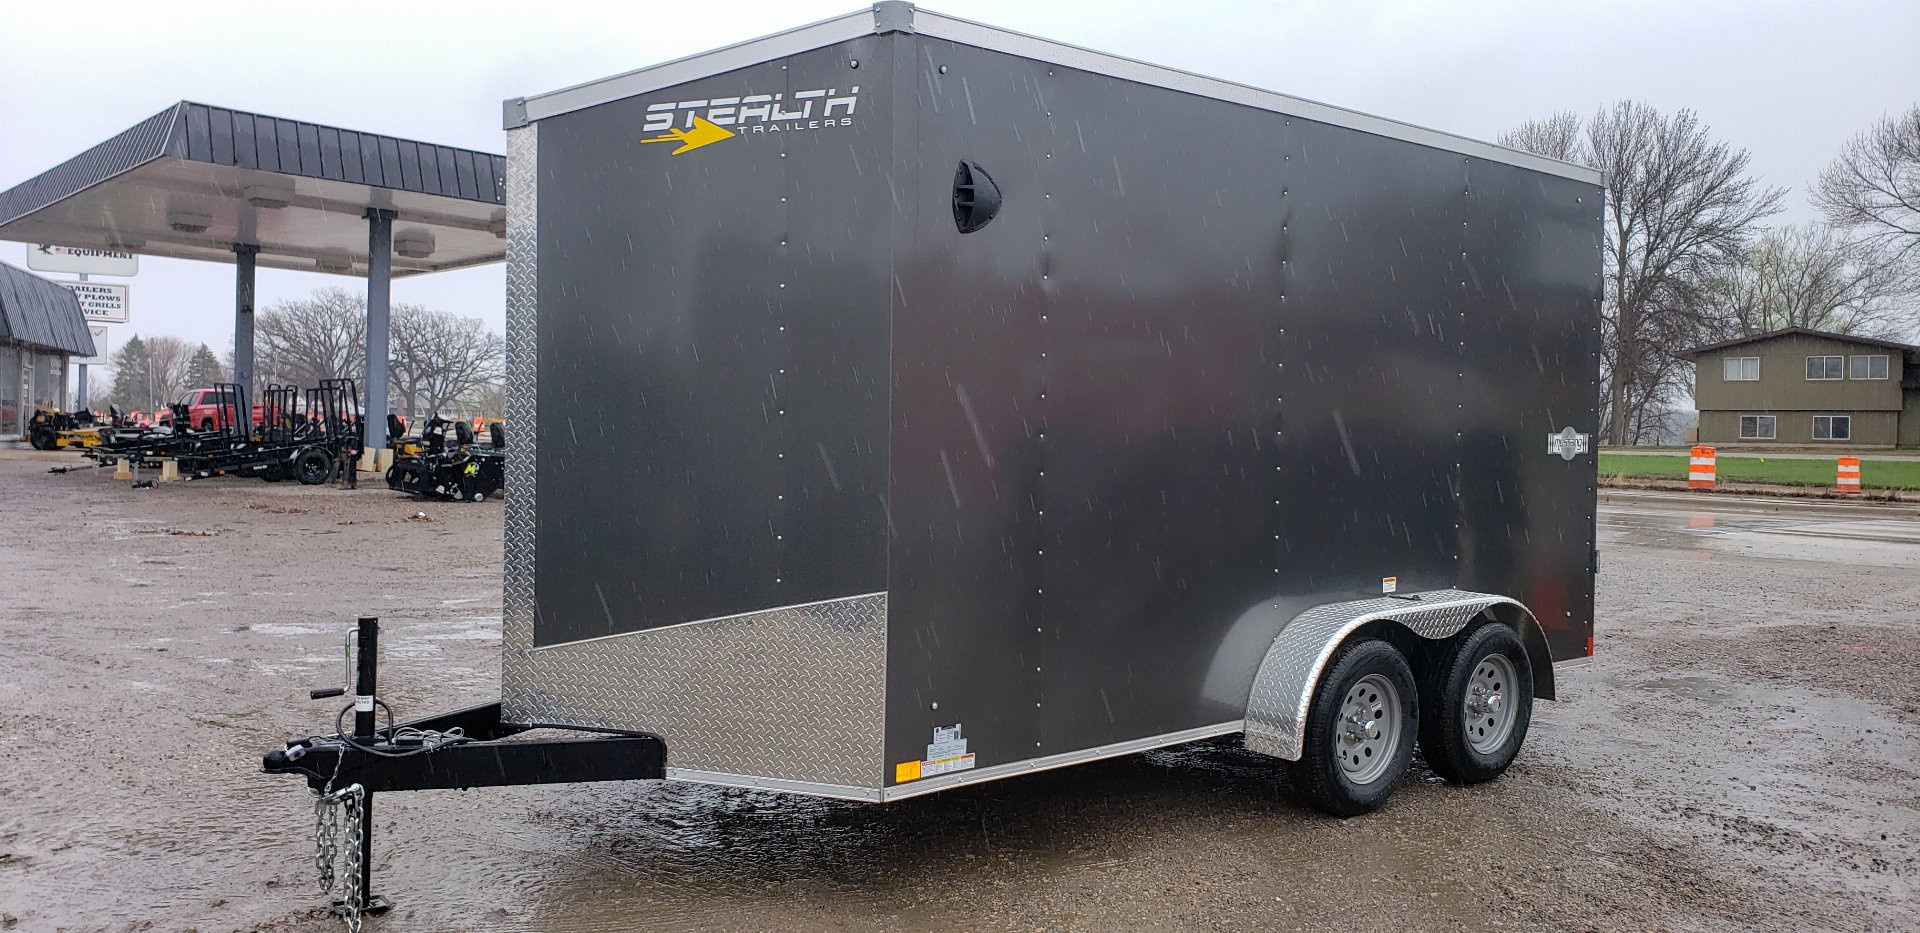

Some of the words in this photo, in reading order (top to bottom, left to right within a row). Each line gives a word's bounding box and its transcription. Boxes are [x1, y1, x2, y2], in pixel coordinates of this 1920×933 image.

[642, 86, 859, 132] STEALTH
[737, 117, 852, 135] TRAILERS
[84, 294, 121, 302] PLOWS
[88, 301, 121, 309] GRILLS
